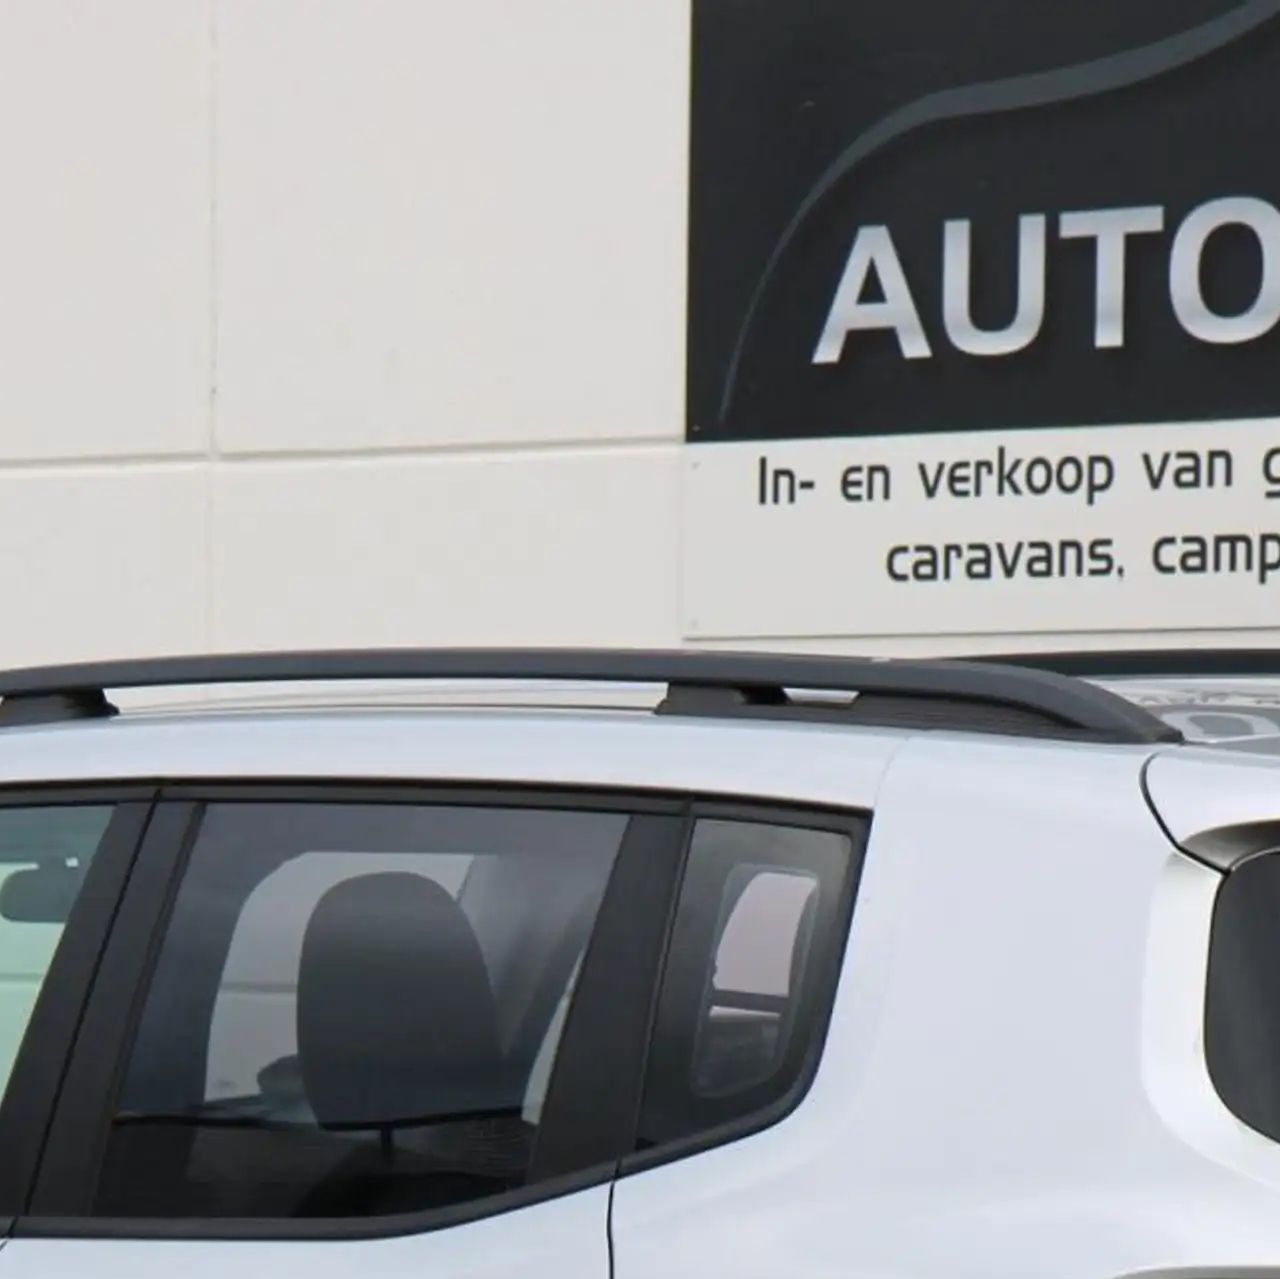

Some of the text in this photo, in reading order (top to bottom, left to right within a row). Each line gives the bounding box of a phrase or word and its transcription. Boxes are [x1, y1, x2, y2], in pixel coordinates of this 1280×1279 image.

[758, 456, 816, 505] In-
[840, 464, 891, 502] en
[918, 446, 1114, 506] verkoop
[1142, 449, 1233, 490] van
[886, 538, 1124, 582] caravans,
